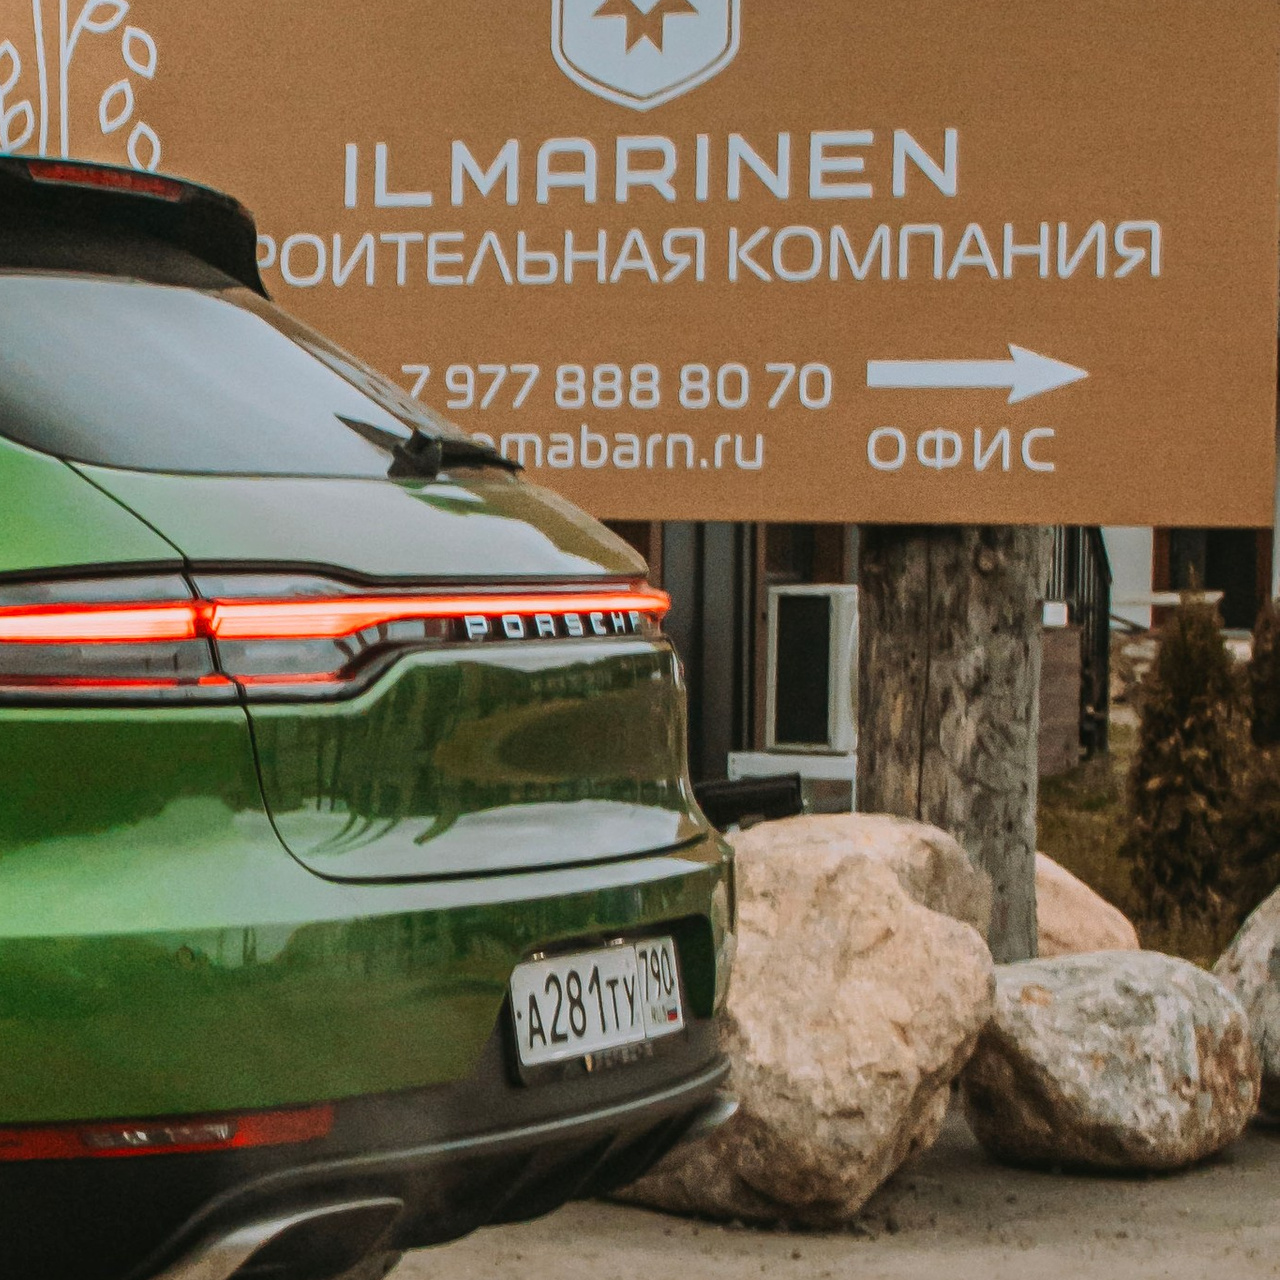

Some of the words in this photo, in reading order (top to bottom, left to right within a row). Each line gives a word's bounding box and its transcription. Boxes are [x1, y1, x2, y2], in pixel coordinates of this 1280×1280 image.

[344, 127, 959, 209] ILMARINEN
[728, 220, 1163, 283] КОМПАНИЯ
[445, 363, 540, 410] 977
[554, 362, 662, 410] 888
[677, 362, 751, 410] 80
[764, 362, 833, 410] 70
[867, 426, 1056, 472] ОФИС
